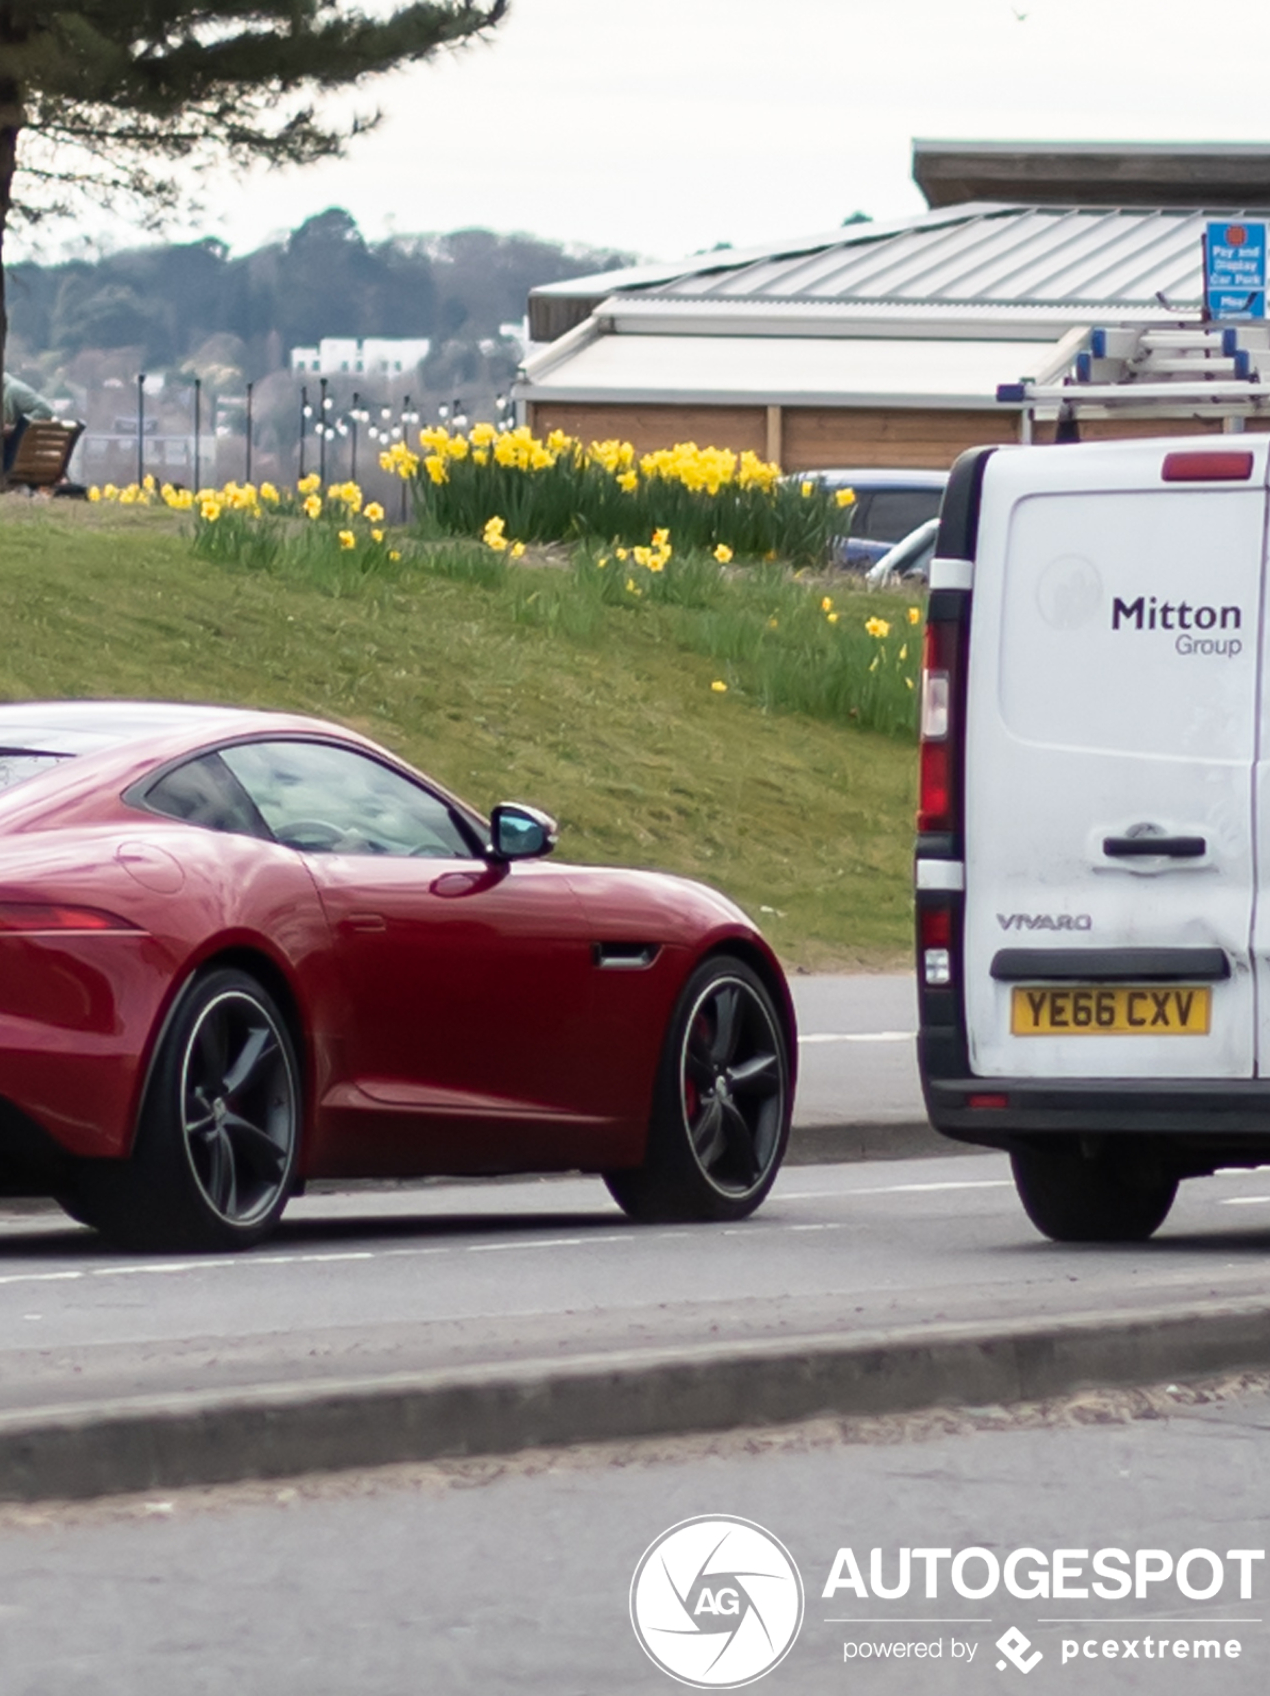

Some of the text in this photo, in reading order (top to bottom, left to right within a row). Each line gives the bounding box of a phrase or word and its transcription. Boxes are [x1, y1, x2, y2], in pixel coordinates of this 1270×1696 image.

[1212, 246, 1260, 258] Pay and
[1214, 260, 1257, 272] Display
[1210, 274, 1261, 285] Car Park
[1112, 596, 1241, 630] Mitton
[1175, 634, 1243, 658] Group
[996, 913, 1092, 931] VIVARO
[1026, 991, 1195, 1027] YE66 CXV
